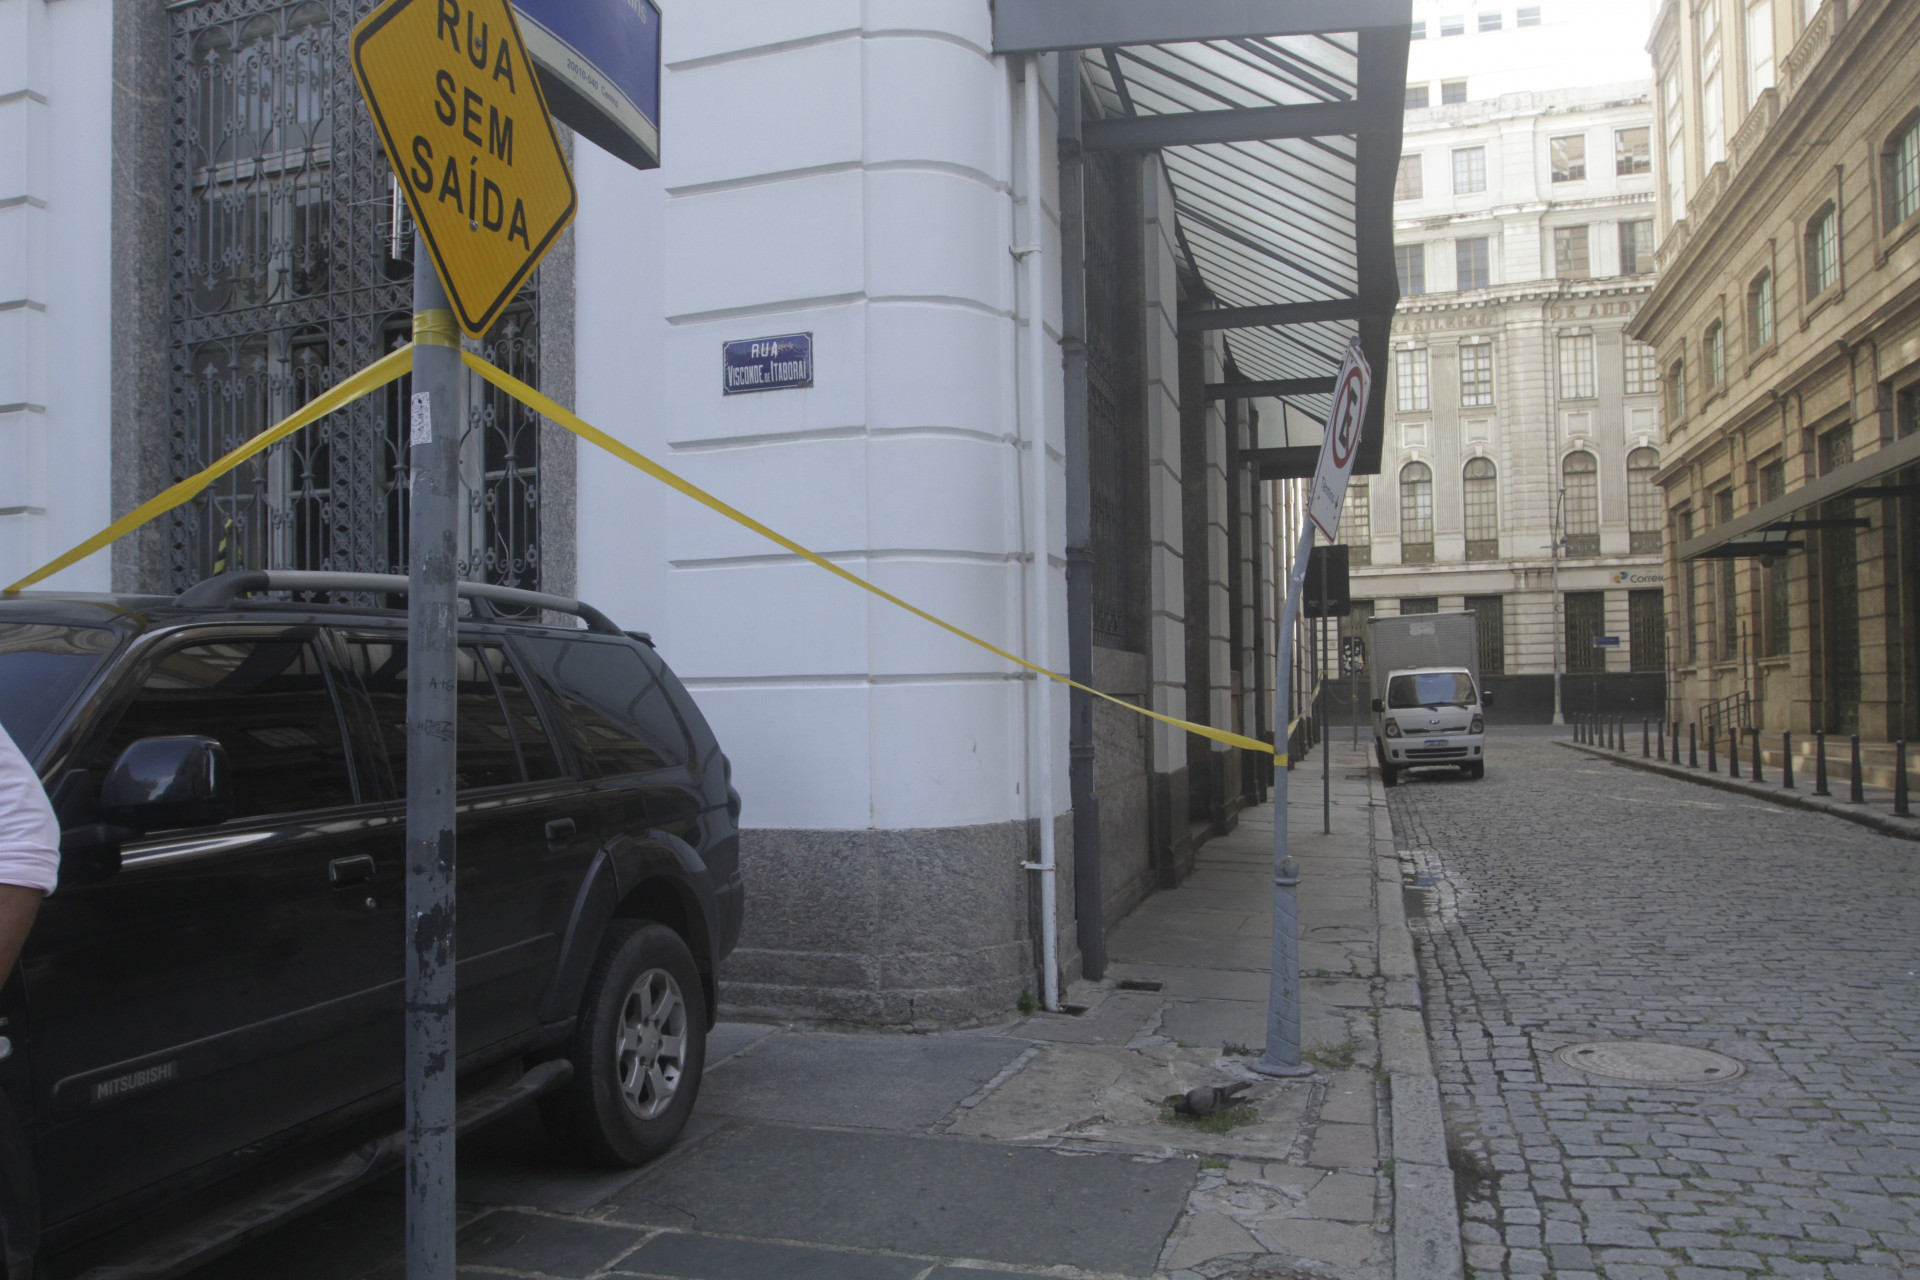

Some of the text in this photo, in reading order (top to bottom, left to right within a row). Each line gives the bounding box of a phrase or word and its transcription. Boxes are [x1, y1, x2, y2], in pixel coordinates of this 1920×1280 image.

[438, 0, 516, 95] RUA
[567, 58, 619, 108] 20010-040 Centro
[435, 69, 513, 167] SEM
[411, 135, 530, 251] SAÍDA
[1551, 305, 1576, 319] DE
[751, 341, 778, 358] RUA
[728, 364, 764, 387] VISCONDE
[764, 373, 771, 383] DE
[97, 1062, 172, 1099] MITSUBISHI
